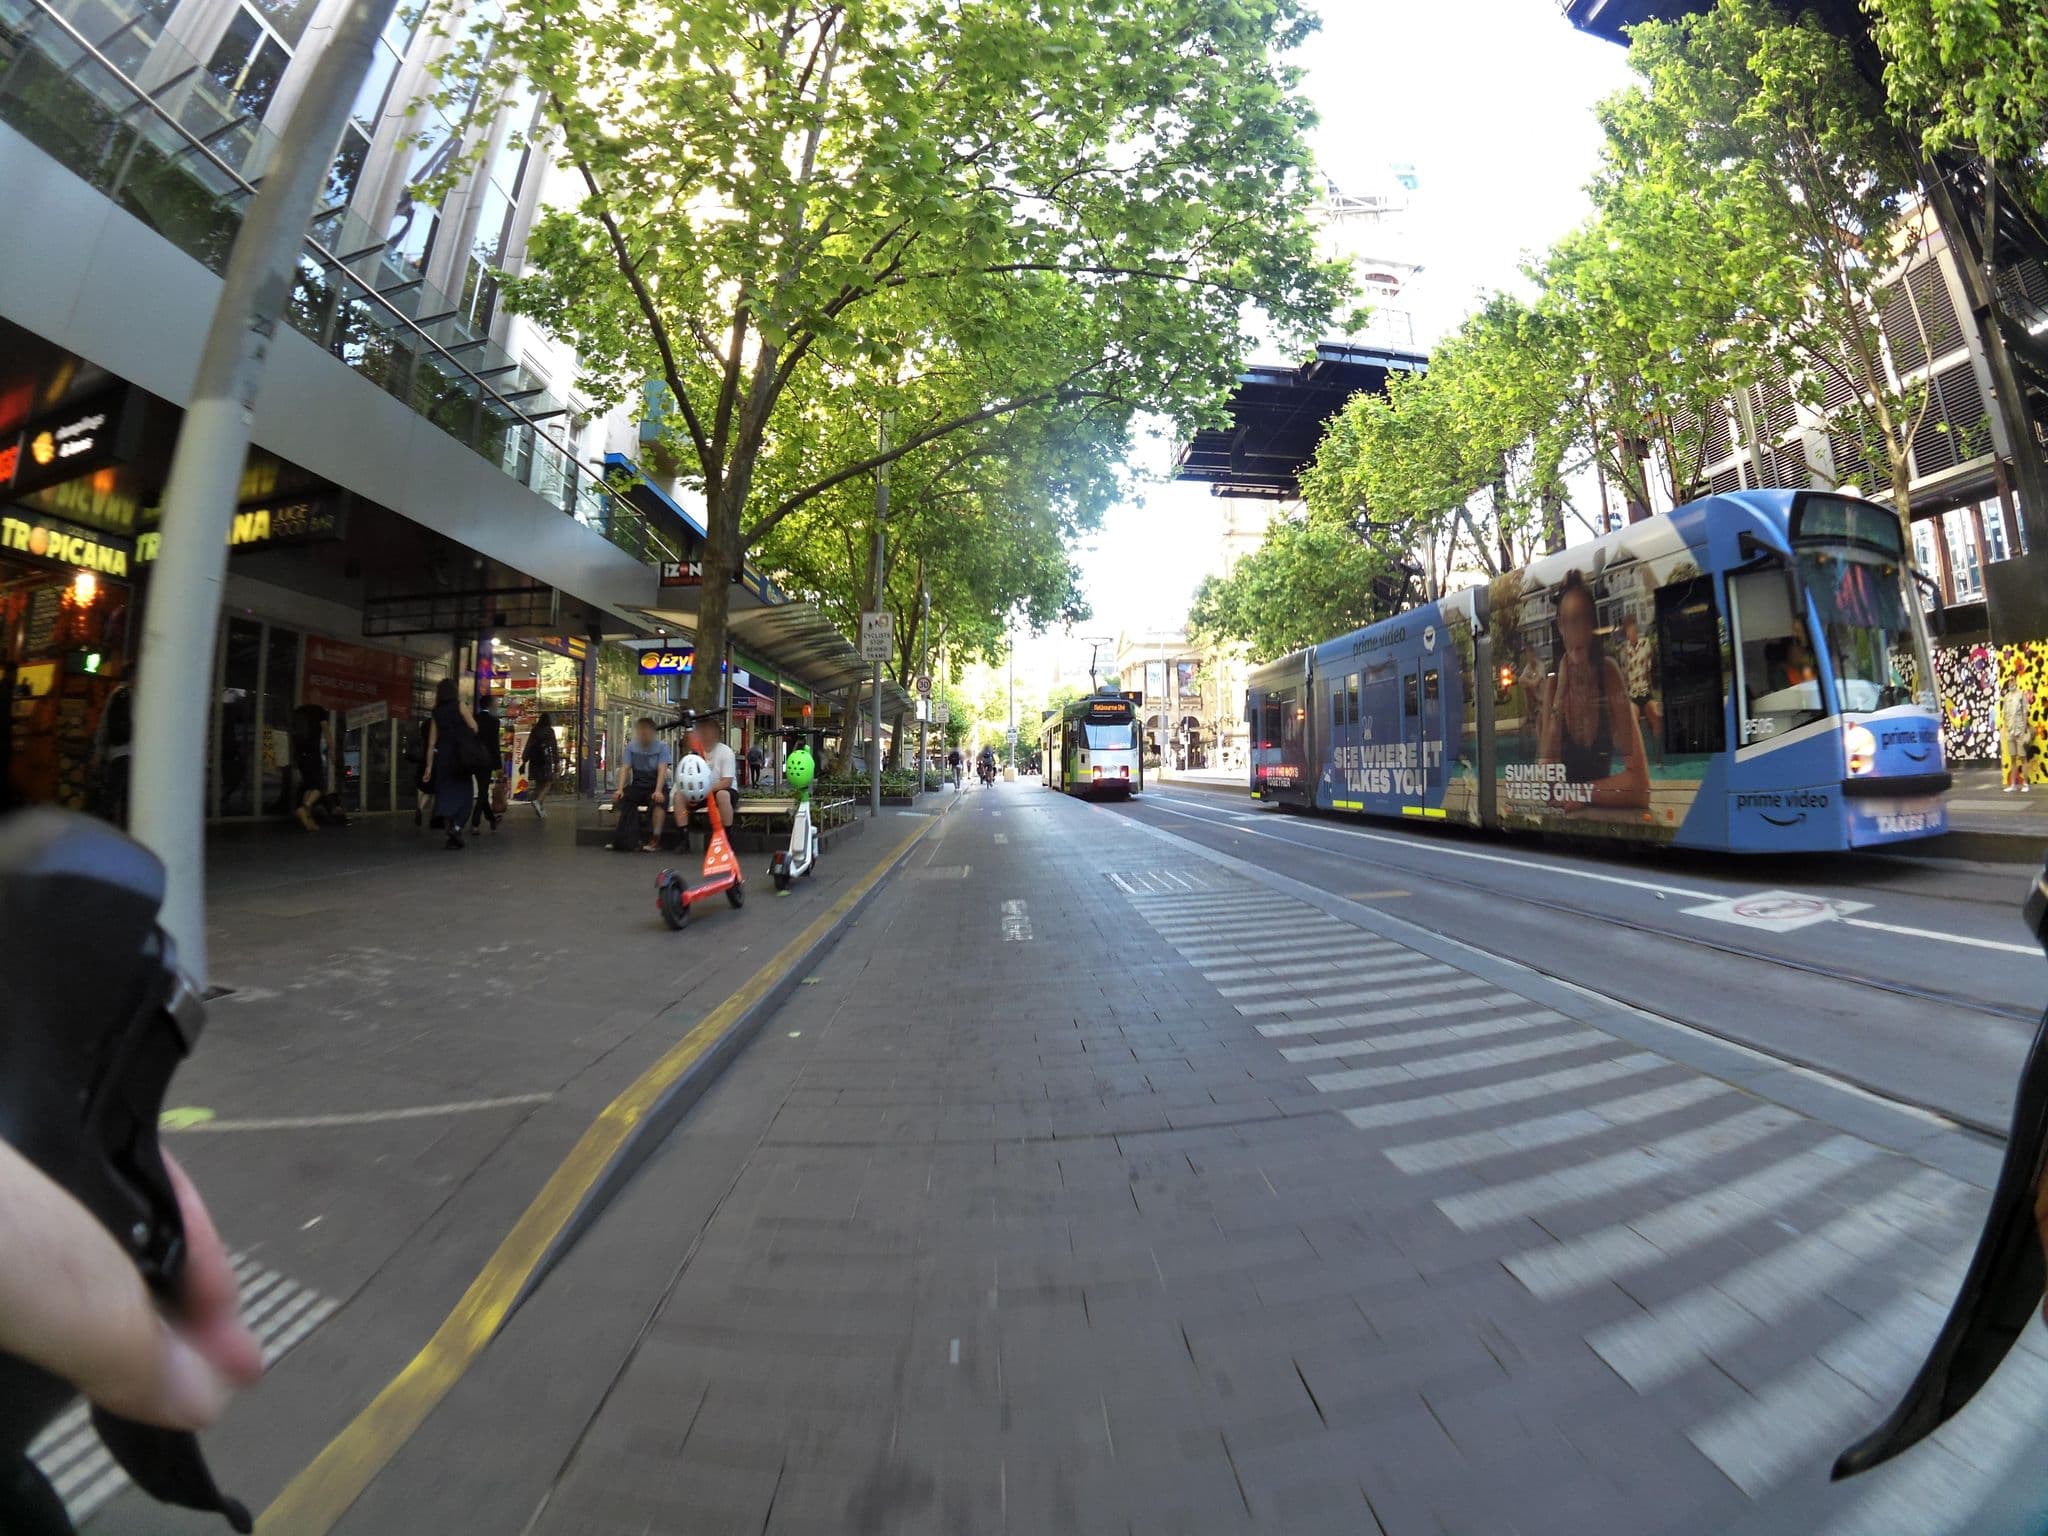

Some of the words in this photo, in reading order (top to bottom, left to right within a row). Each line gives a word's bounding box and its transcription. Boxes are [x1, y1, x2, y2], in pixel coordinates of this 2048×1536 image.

[863, 632, 891, 640] CYCLISTS
[1353, 633, 1378, 661] prime
[1379, 626, 1406, 648] video
[919, 680, 929, 689] 30
[1881, 727, 1917, 750] prime
[1334, 746, 1359, 769] SEE
[1361, 743, 1418, 769] WHERE
[1422, 741, 1443, 768] IT
[1345, 768, 1392, 794] TAKES
[1392, 768, 1428, 796] YOU
[1504, 763, 1567, 782] SUMMER
[1505, 782, 1552, 801] VIBES
[1553, 782, 1595, 803] ONLY
[1736, 790, 1782, 811] prime
[1786, 791, 1829, 810] video
